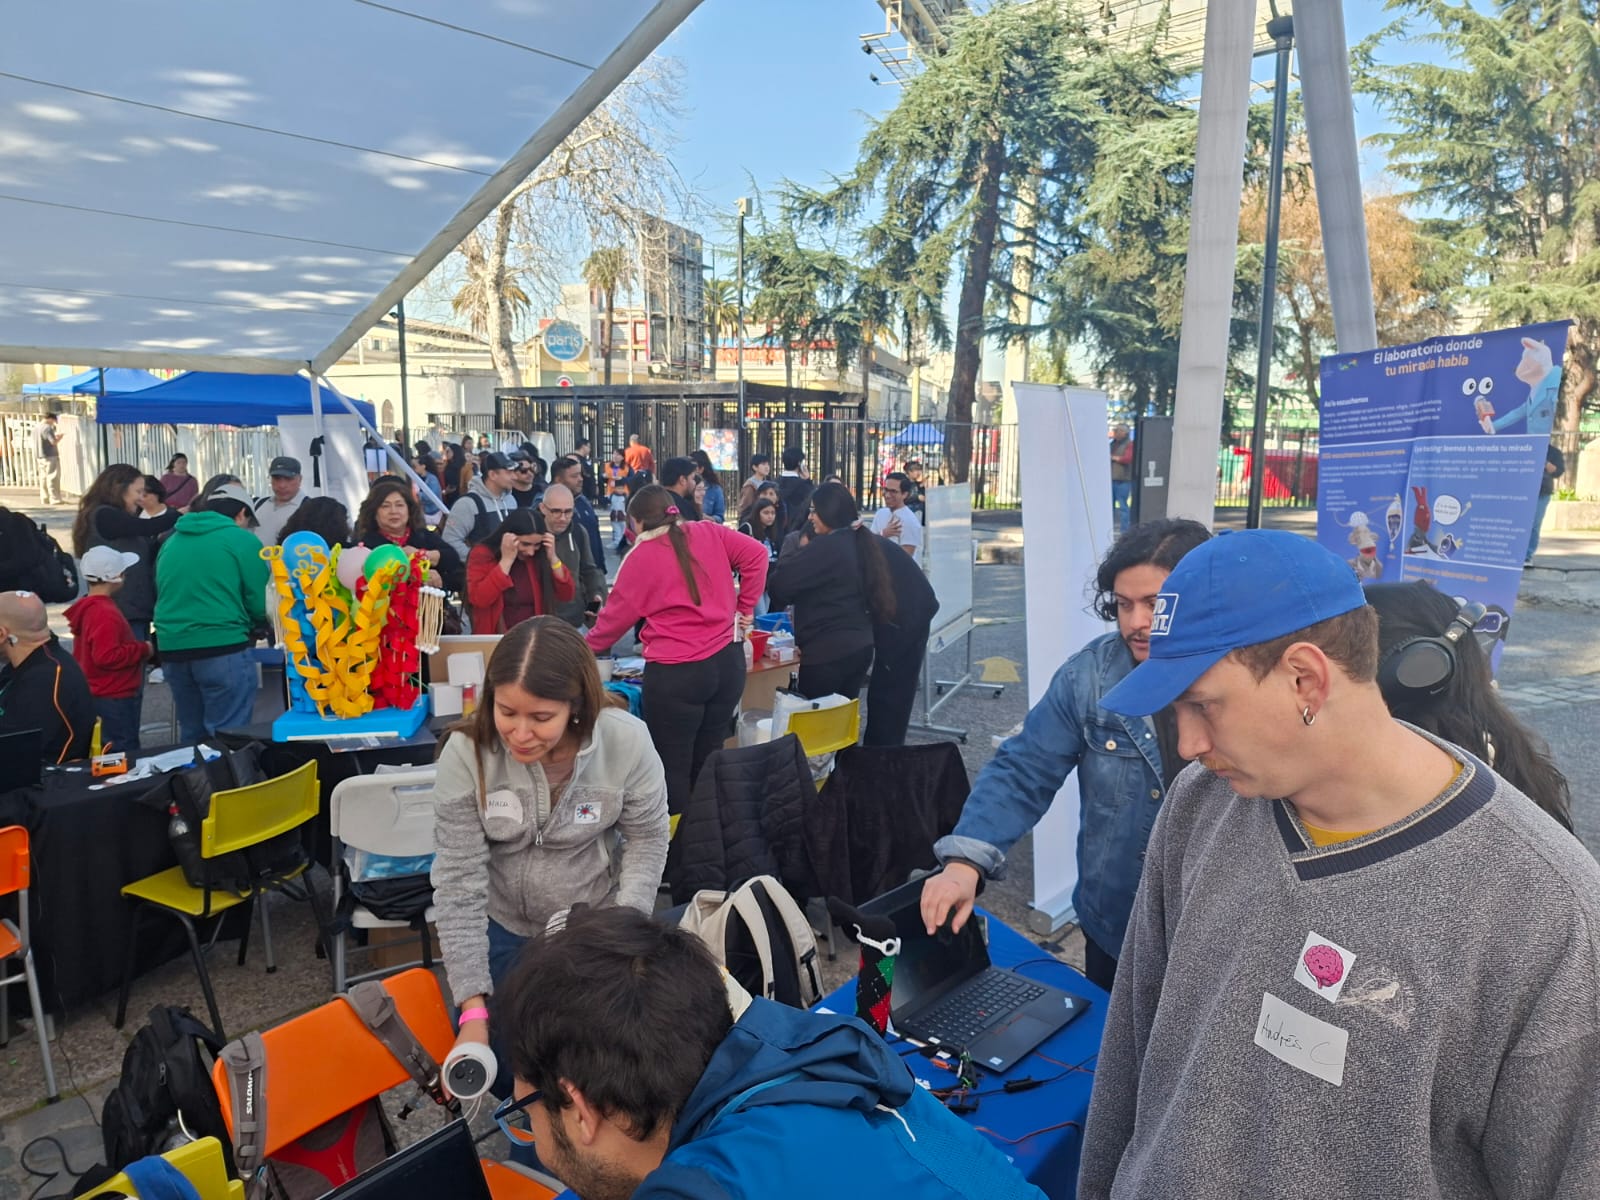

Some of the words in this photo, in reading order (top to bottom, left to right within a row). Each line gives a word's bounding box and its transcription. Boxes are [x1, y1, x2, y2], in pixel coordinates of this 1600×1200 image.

[1373, 351, 1383, 365] El
[1384, 341, 1444, 362] laboratorio
[1445, 336, 1483, 353] donde
[1385, 366, 1397, 377] tu
[1398, 358, 1436, 375] mirada
[1437, 353, 1469, 369] habla
[1508, 444, 1533, 452] mirada
[1310, 1042, 1343, 1065] C
